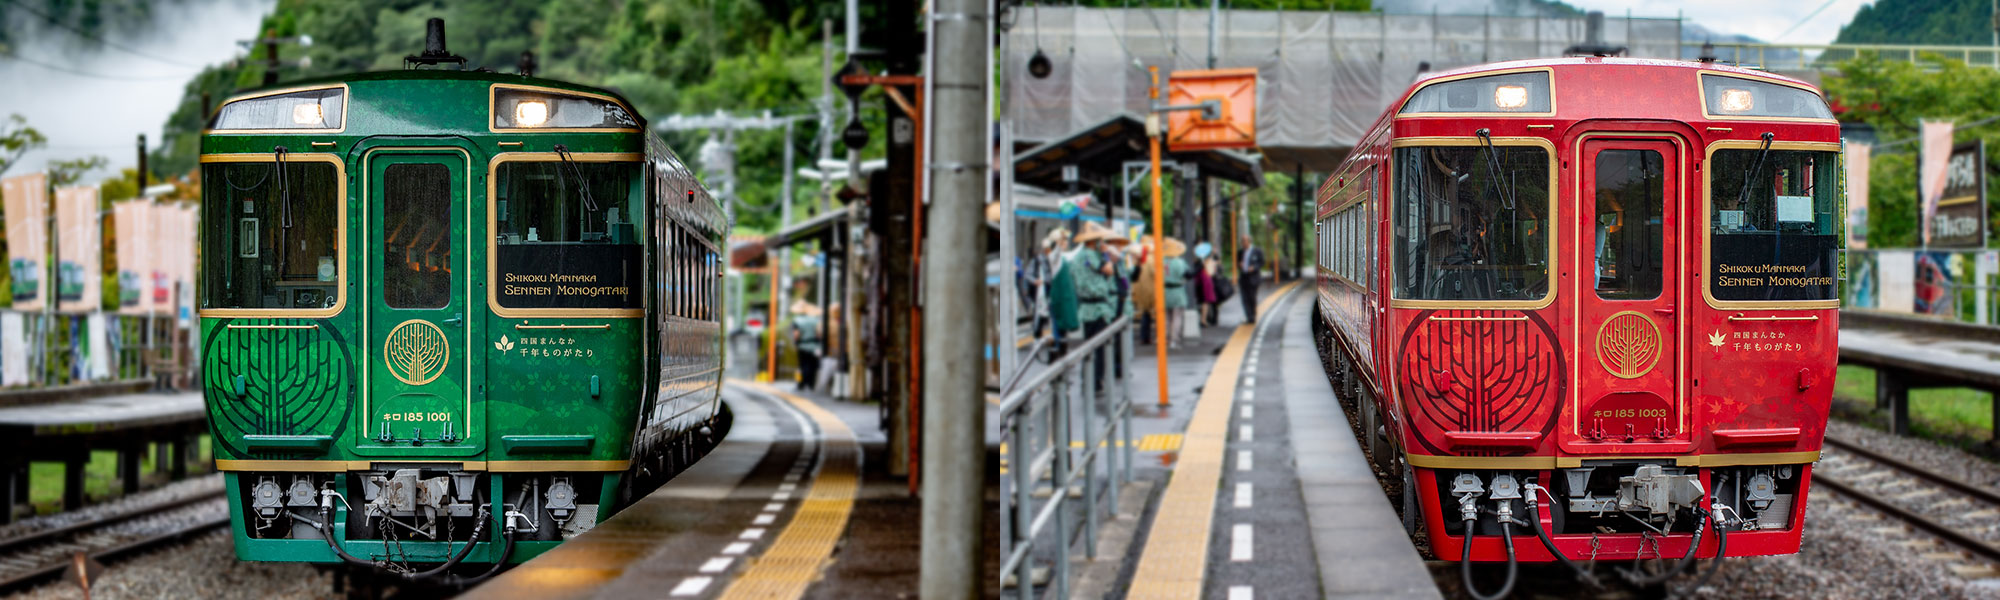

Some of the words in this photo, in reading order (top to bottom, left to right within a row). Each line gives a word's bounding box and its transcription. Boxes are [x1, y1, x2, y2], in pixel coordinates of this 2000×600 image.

[1733, 331, 1786, 339] 四国まんなか
[520, 337, 576, 345] 四国まんなか
[1732, 342, 1802, 352] 千年ものがたり
[519, 348, 593, 357] 千年ものがたり
[384, 413, 401, 421] キロ
[404, 413, 423, 421] 185
[427, 413, 450, 421] 1001
[1615, 409, 1635, 417] 185
[1639, 409, 1666, 417] 1003
